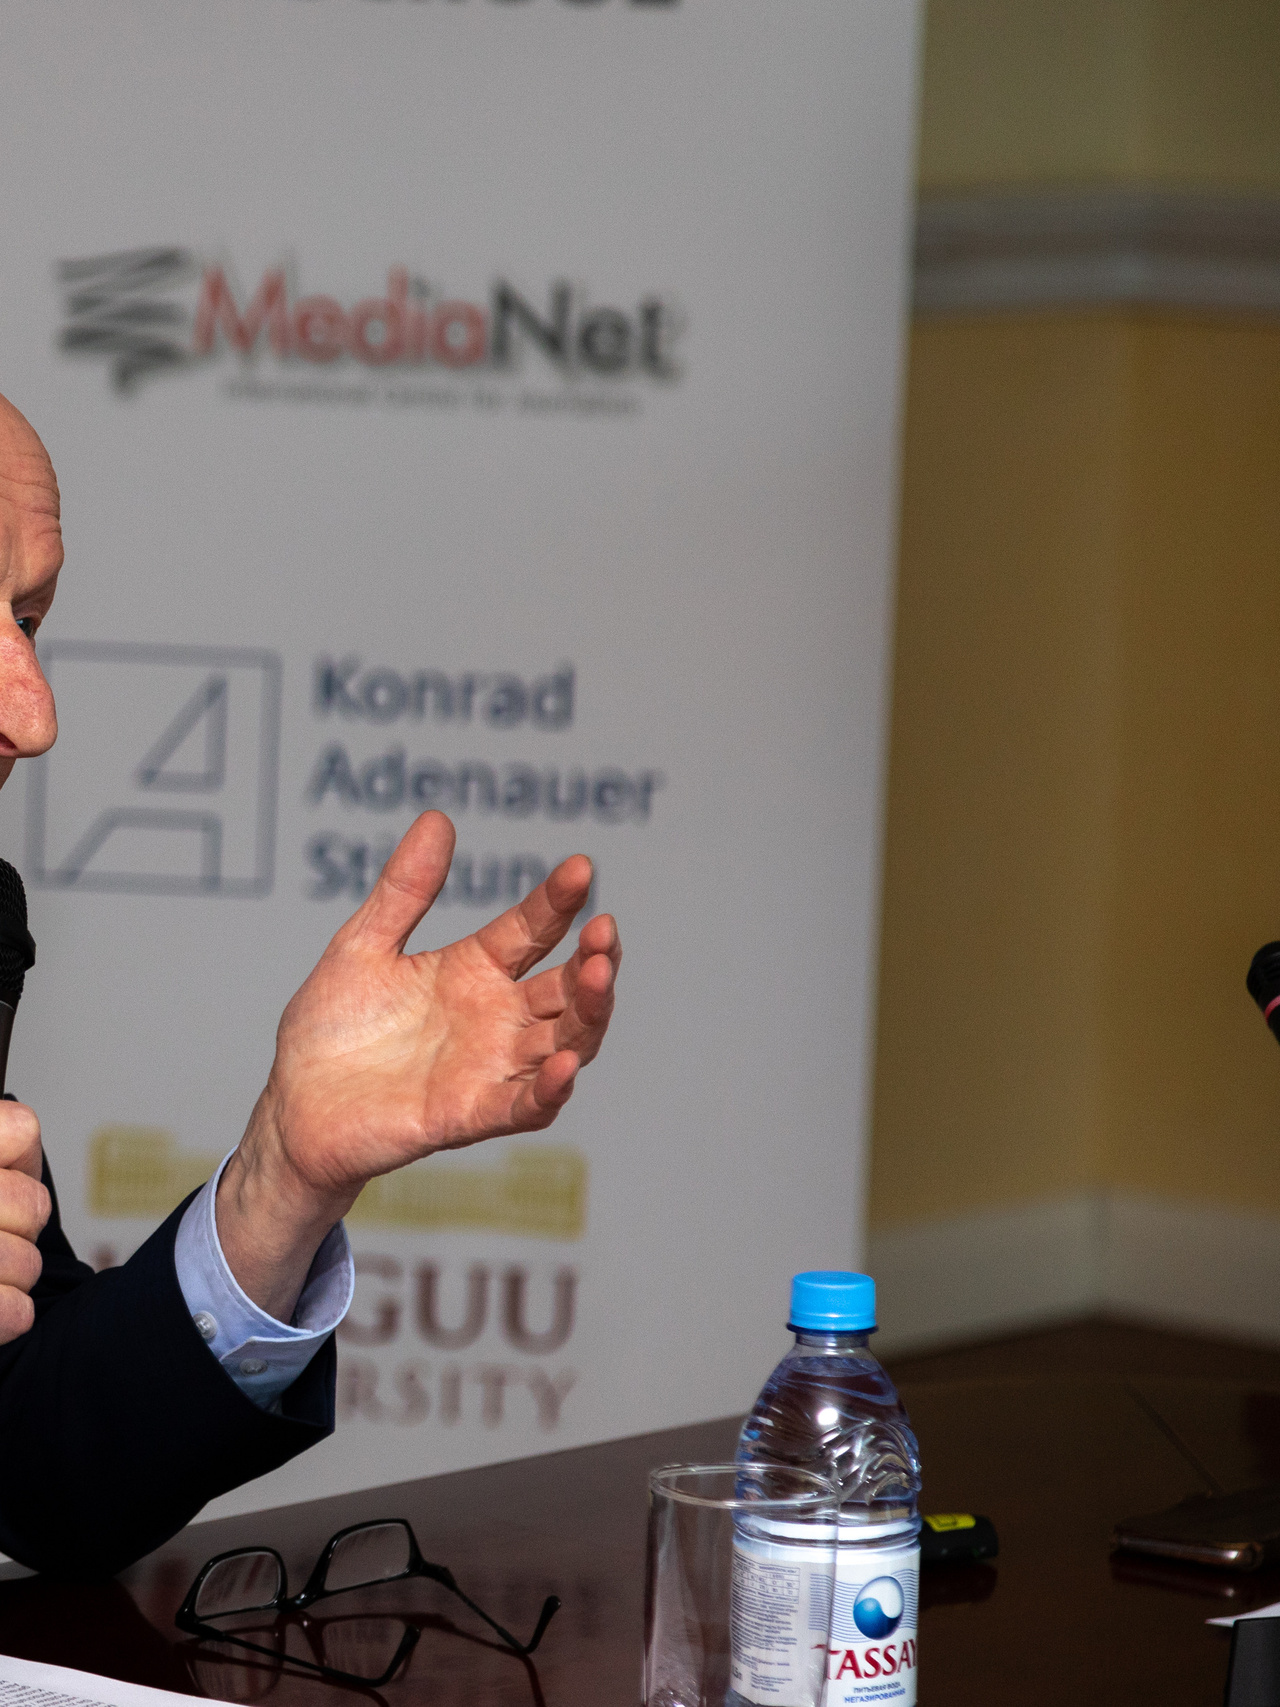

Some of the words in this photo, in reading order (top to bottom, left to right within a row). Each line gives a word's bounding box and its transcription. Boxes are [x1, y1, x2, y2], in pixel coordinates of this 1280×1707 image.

[194, 262, 680, 386] MediaNet
[311, 655, 576, 732] Konrad
[306, 742, 660, 824] Adenauer
[333, 1255, 577, 1354] GUU
[336, 1359, 576, 1432] RSITY
